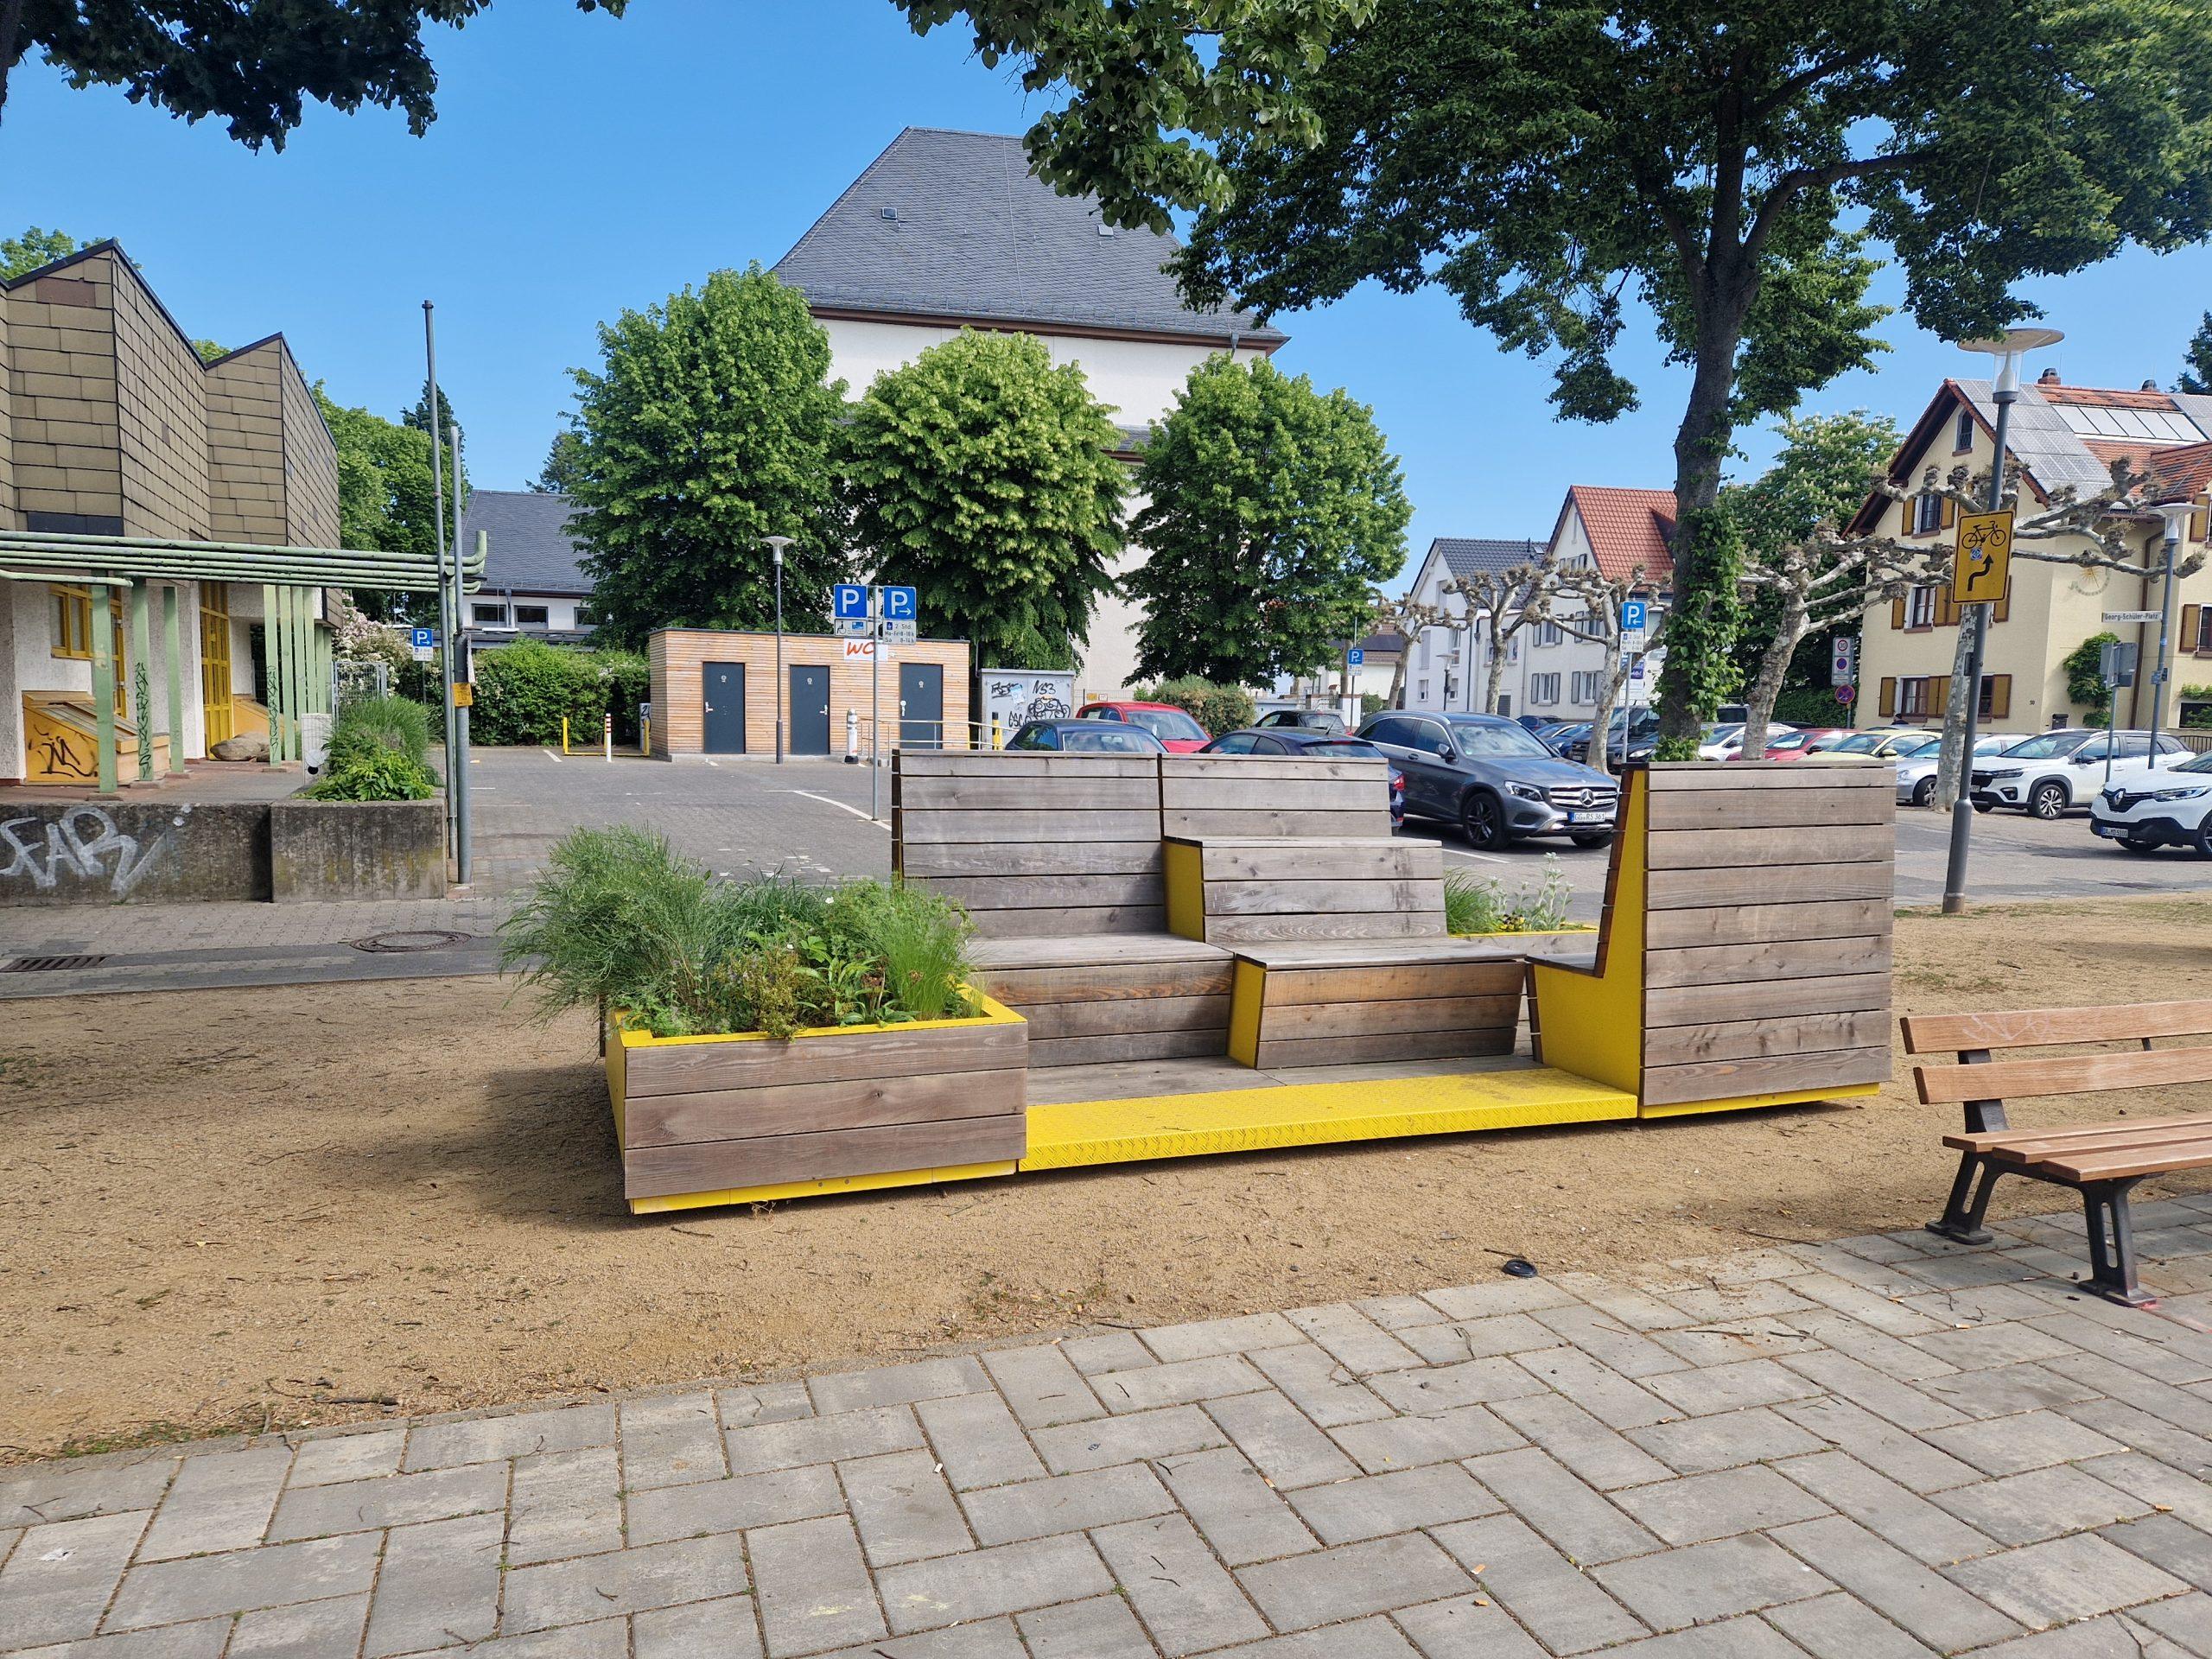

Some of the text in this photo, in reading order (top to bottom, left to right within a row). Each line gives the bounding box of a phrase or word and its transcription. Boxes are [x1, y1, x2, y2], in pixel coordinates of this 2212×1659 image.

[842, 588, 860, 614] P
[891, 590, 908, 615] P
[1627, 605, 1640, 626] P
[2105, 613, 2158, 621] Georg-Schüler-Platz
[416, 631, 428, 645] P
[847, 641, 874, 656] WC
[1351, 651, 1360, 663] P
